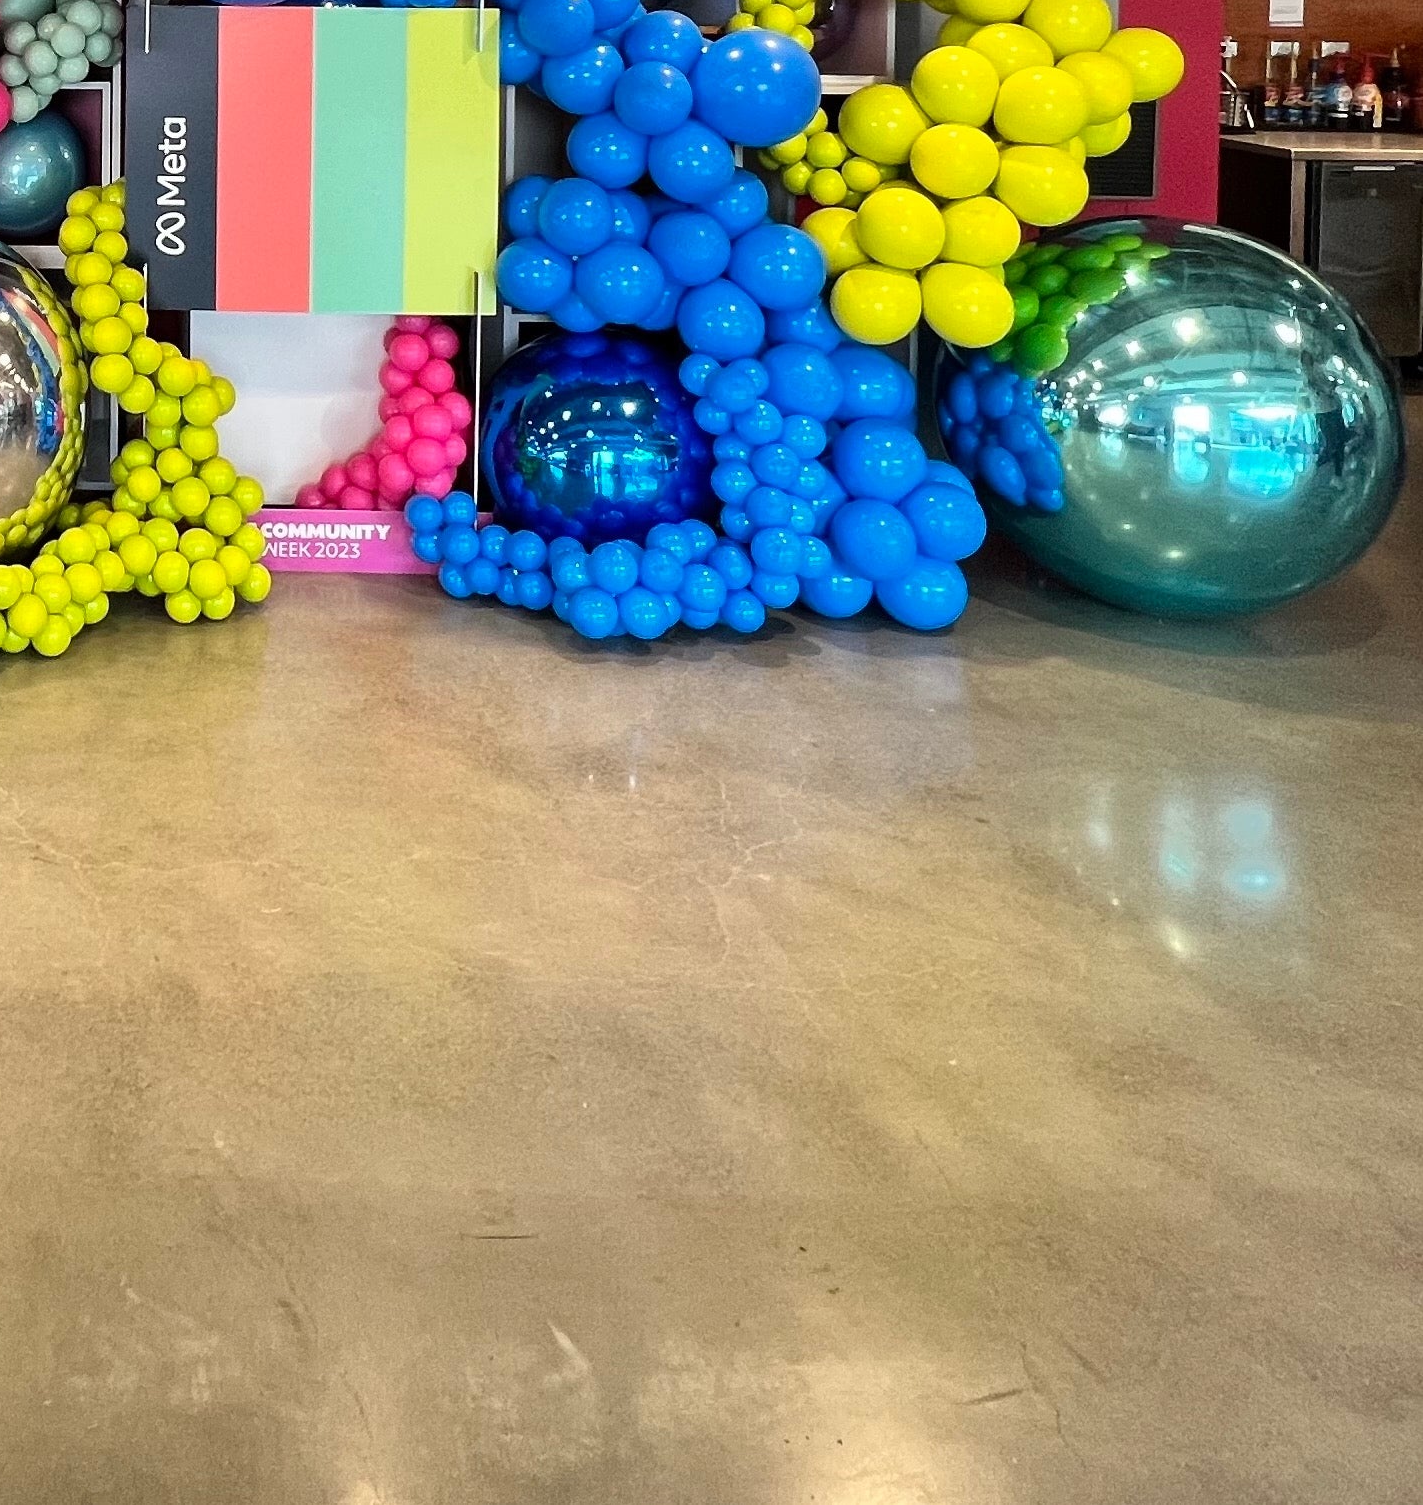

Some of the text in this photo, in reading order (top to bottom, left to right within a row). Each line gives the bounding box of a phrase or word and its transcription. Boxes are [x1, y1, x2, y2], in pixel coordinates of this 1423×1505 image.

[156, 116, 187, 206] Meta
[260, 521, 391, 541] COMMUNITY
[314, 542, 361, 559] 2023
